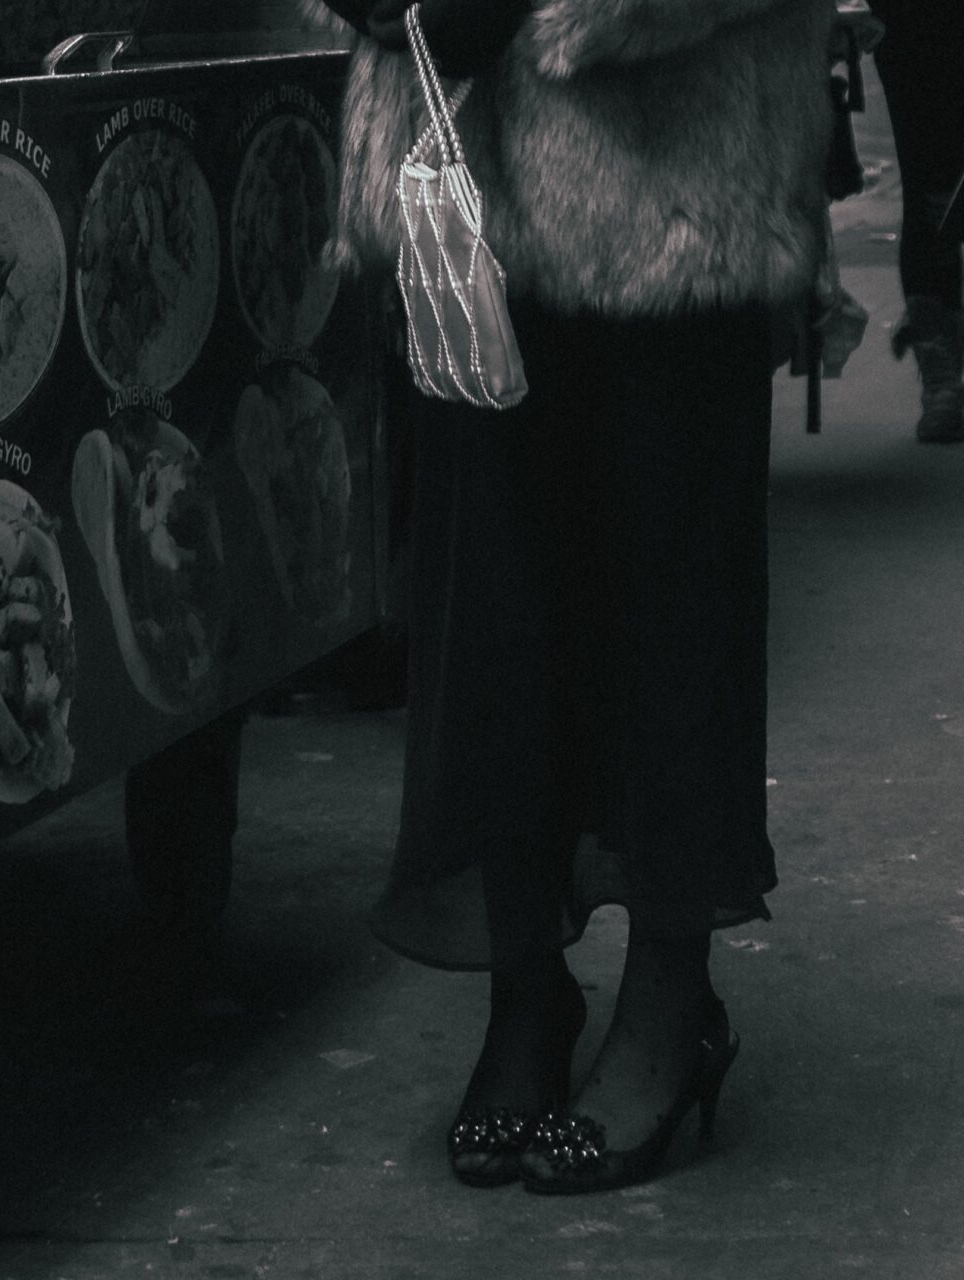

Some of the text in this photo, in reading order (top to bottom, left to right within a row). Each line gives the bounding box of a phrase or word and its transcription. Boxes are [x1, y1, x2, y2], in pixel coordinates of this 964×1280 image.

[96, 98, 197, 153] LAMB OVER RICE
[15, 128, 52, 179] RICE
[106, 385, 172, 420] LAMB GYRO
